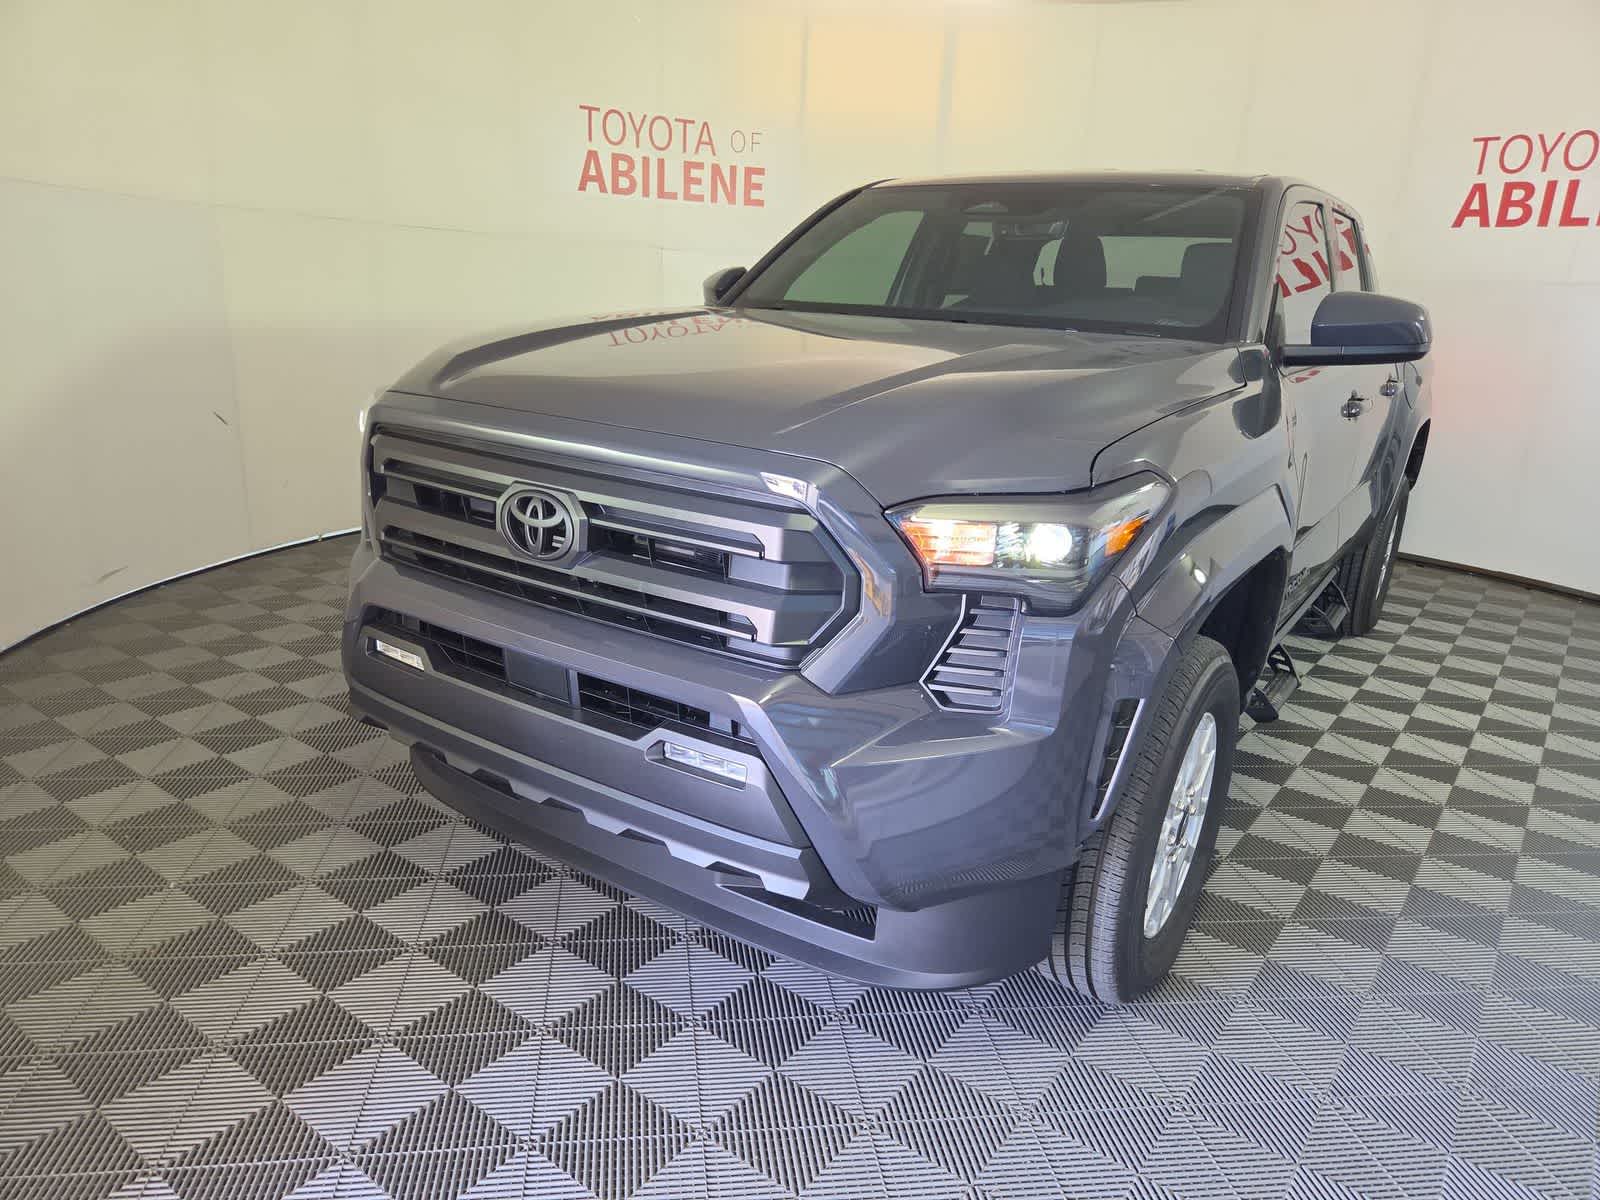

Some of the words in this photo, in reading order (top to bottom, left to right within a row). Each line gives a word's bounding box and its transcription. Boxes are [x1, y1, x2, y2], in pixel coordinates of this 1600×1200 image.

[579, 105, 716, 156] TOYOTA
[730, 130, 763, 153] OF
[1473, 130, 1600, 175] TOYO
[577, 149, 765, 208] ABILENE
[1451, 179, 1600, 228] ABIL
